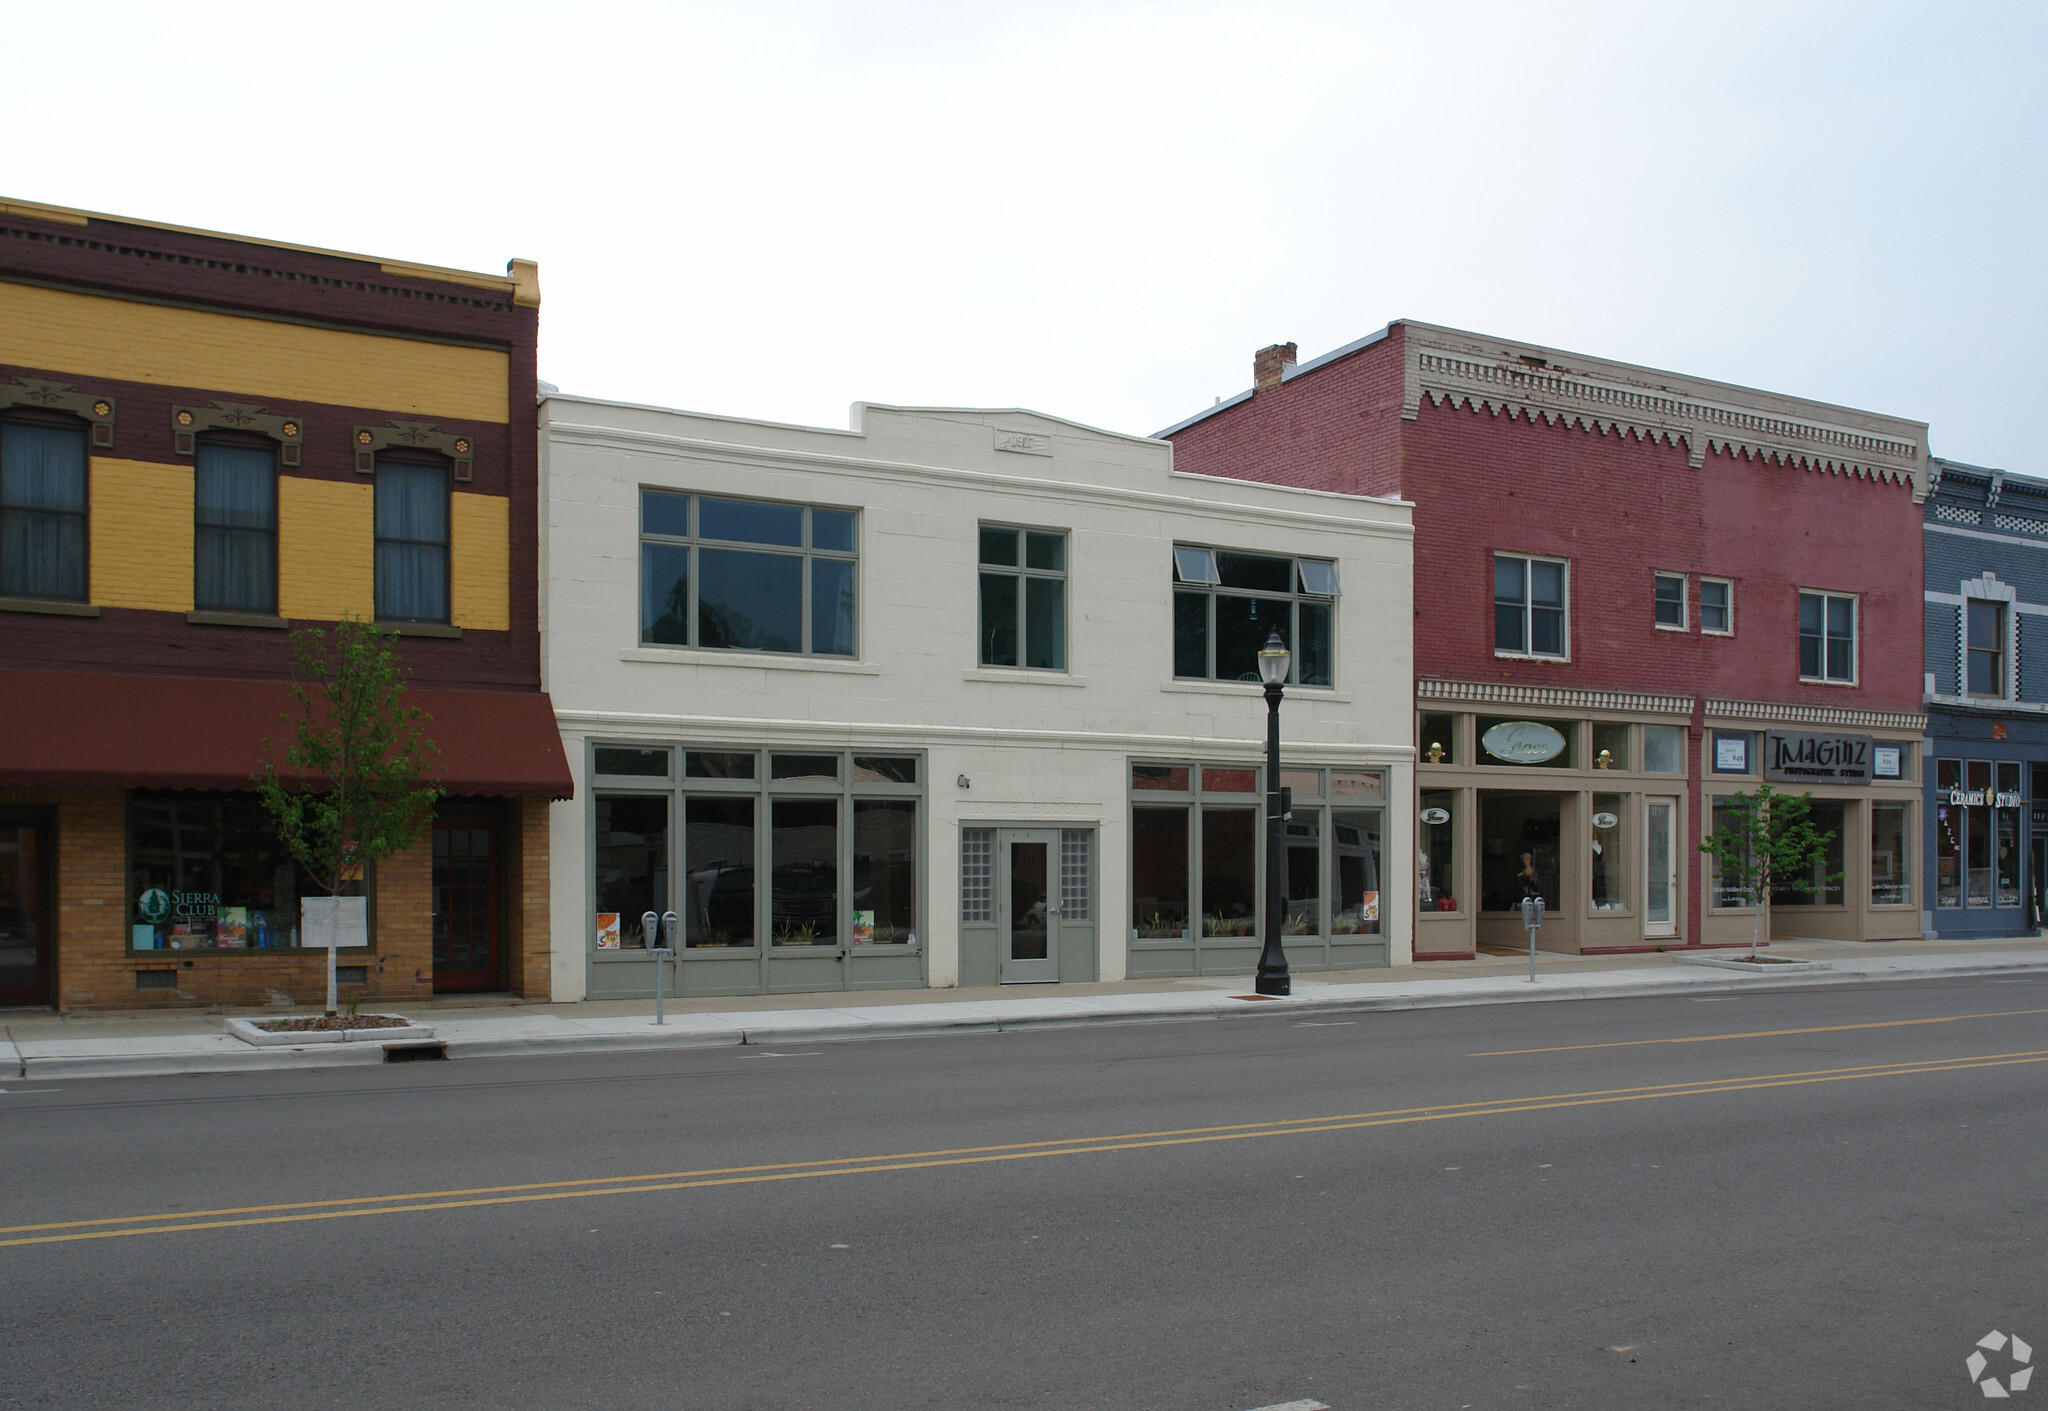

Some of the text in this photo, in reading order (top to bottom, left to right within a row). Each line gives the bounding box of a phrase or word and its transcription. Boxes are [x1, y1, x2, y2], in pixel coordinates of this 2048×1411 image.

[1950, 790, 2021, 809] CERAMICS STUDIO
[1031, 803, 1084, 816] BLOCK
[171, 889, 221, 904] SIERRA
[176, 903, 216, 916] CLUB
